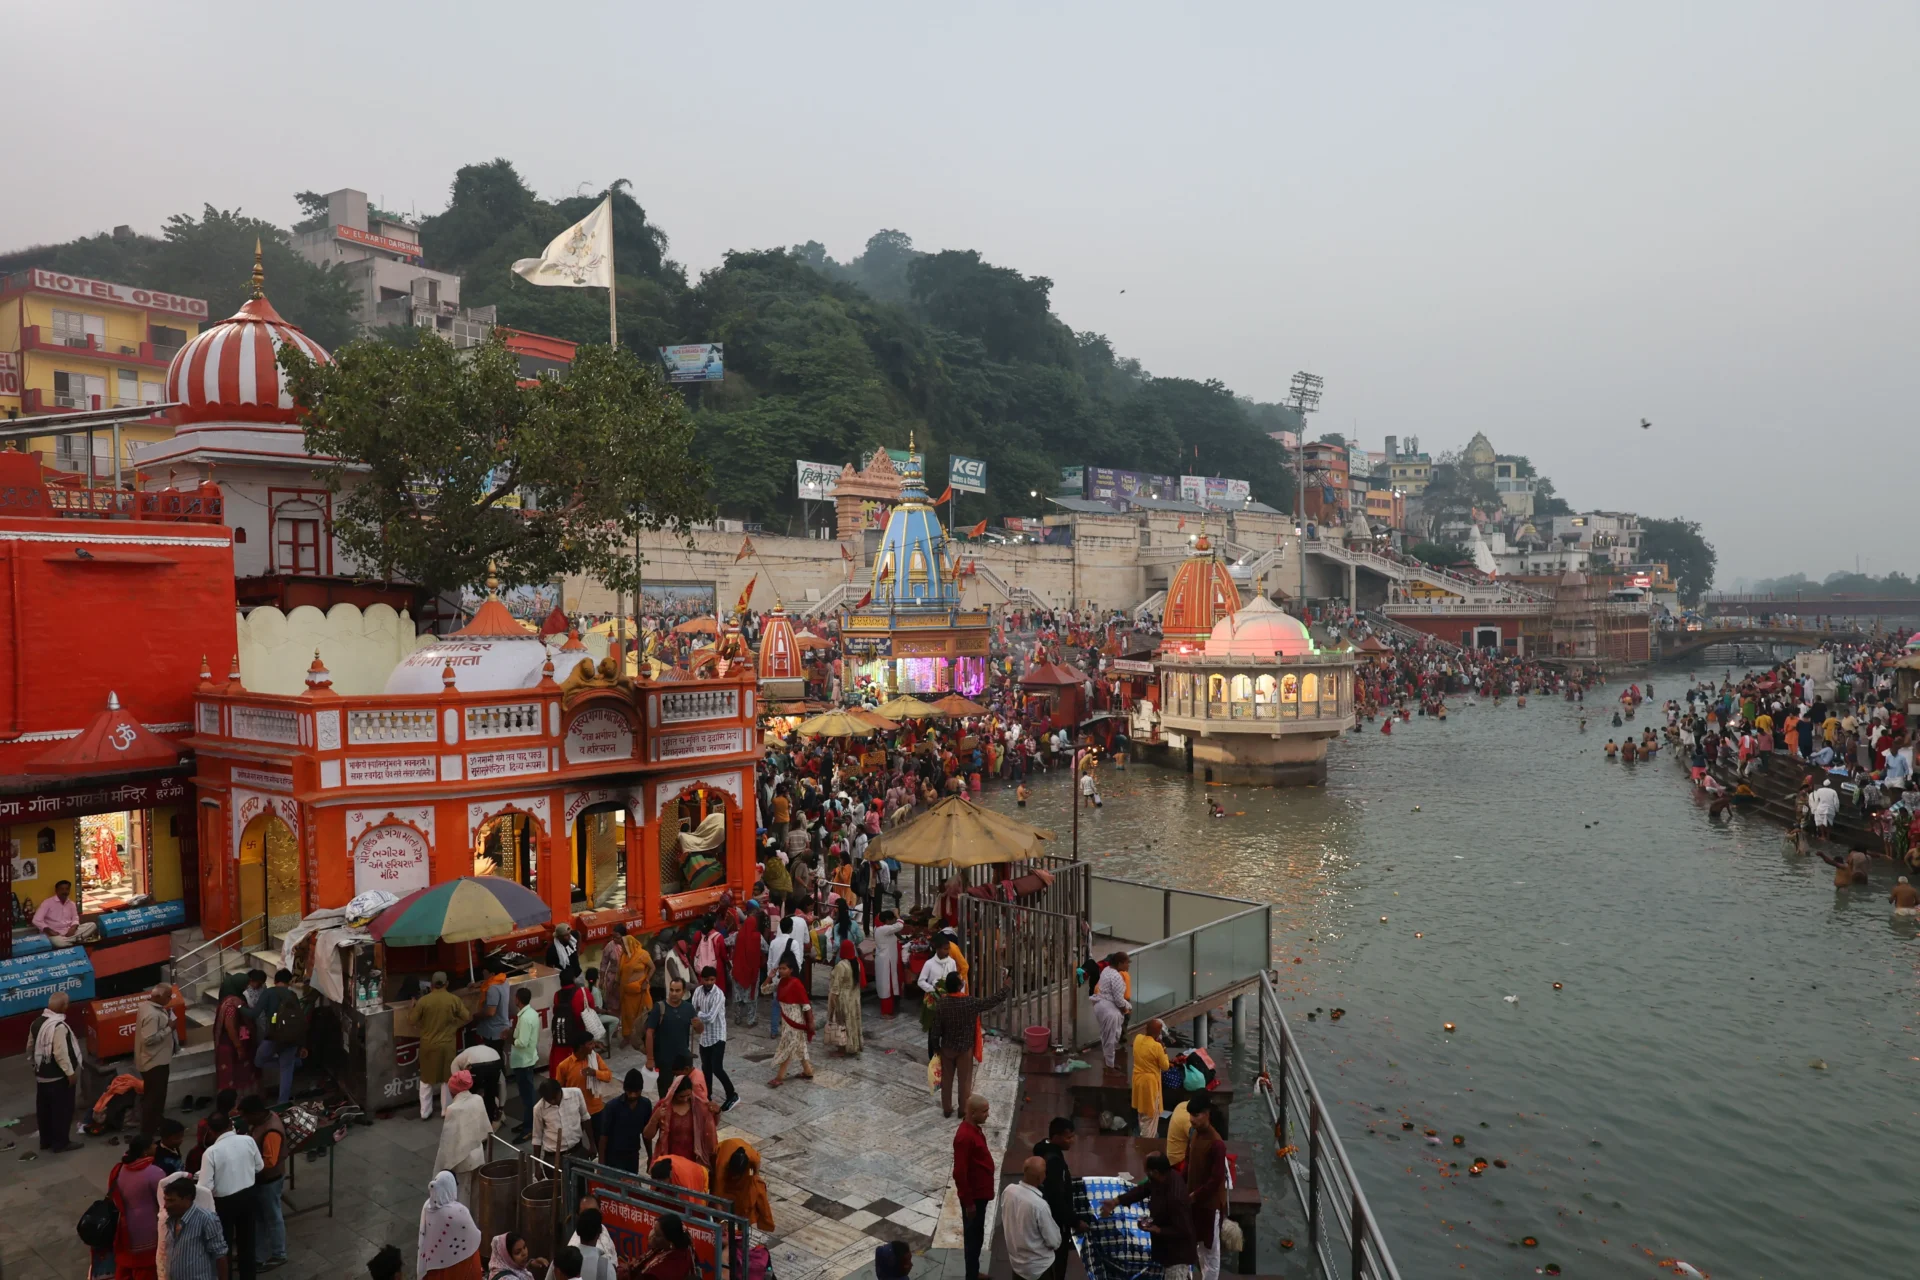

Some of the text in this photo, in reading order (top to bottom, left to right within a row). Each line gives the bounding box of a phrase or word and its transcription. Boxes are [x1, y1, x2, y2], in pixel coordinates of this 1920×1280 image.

[388, 239, 420, 253] DARSHAN
[38, 271, 206, 315] HOTEL OSHO
[952, 458, 984, 477] KEI
[565, 791, 590, 822] आरती
[122, 924, 149, 935] CHARITY
